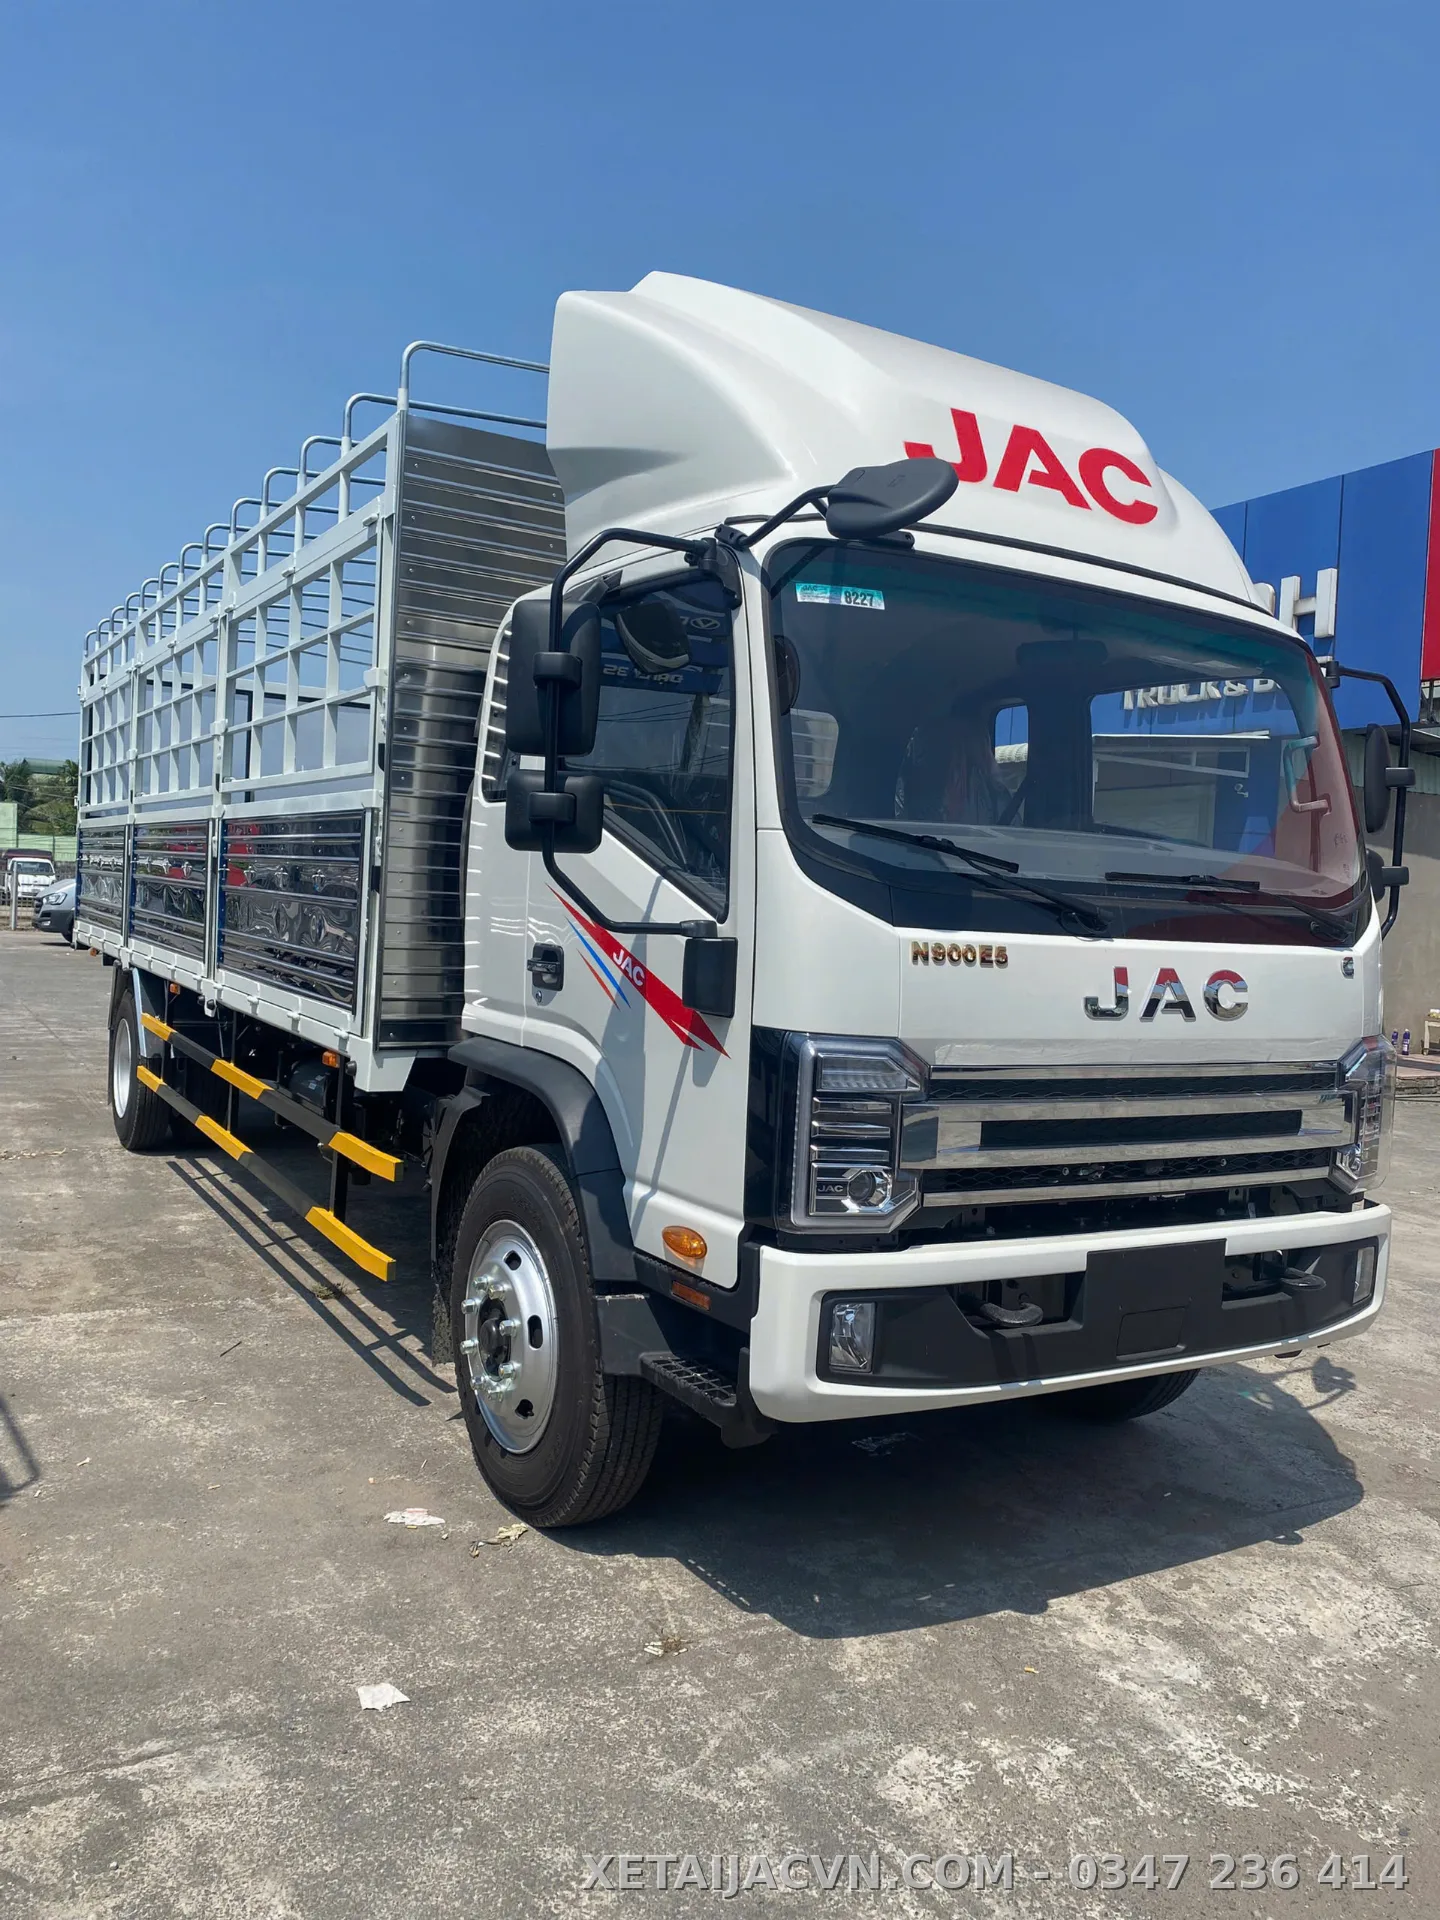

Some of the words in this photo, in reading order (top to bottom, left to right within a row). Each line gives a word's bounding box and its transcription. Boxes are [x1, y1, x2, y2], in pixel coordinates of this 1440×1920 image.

[904, 407, 1159, 525] JAC
[844, 590, 874, 607] 8227
[1253, 568, 1338, 638] H
[612, 949, 645, 987] JAC
[911, 941, 1009, 968] N900E5
[1083, 966, 1249, 1022] JAC
[817, 1184, 844, 1193] JAC
